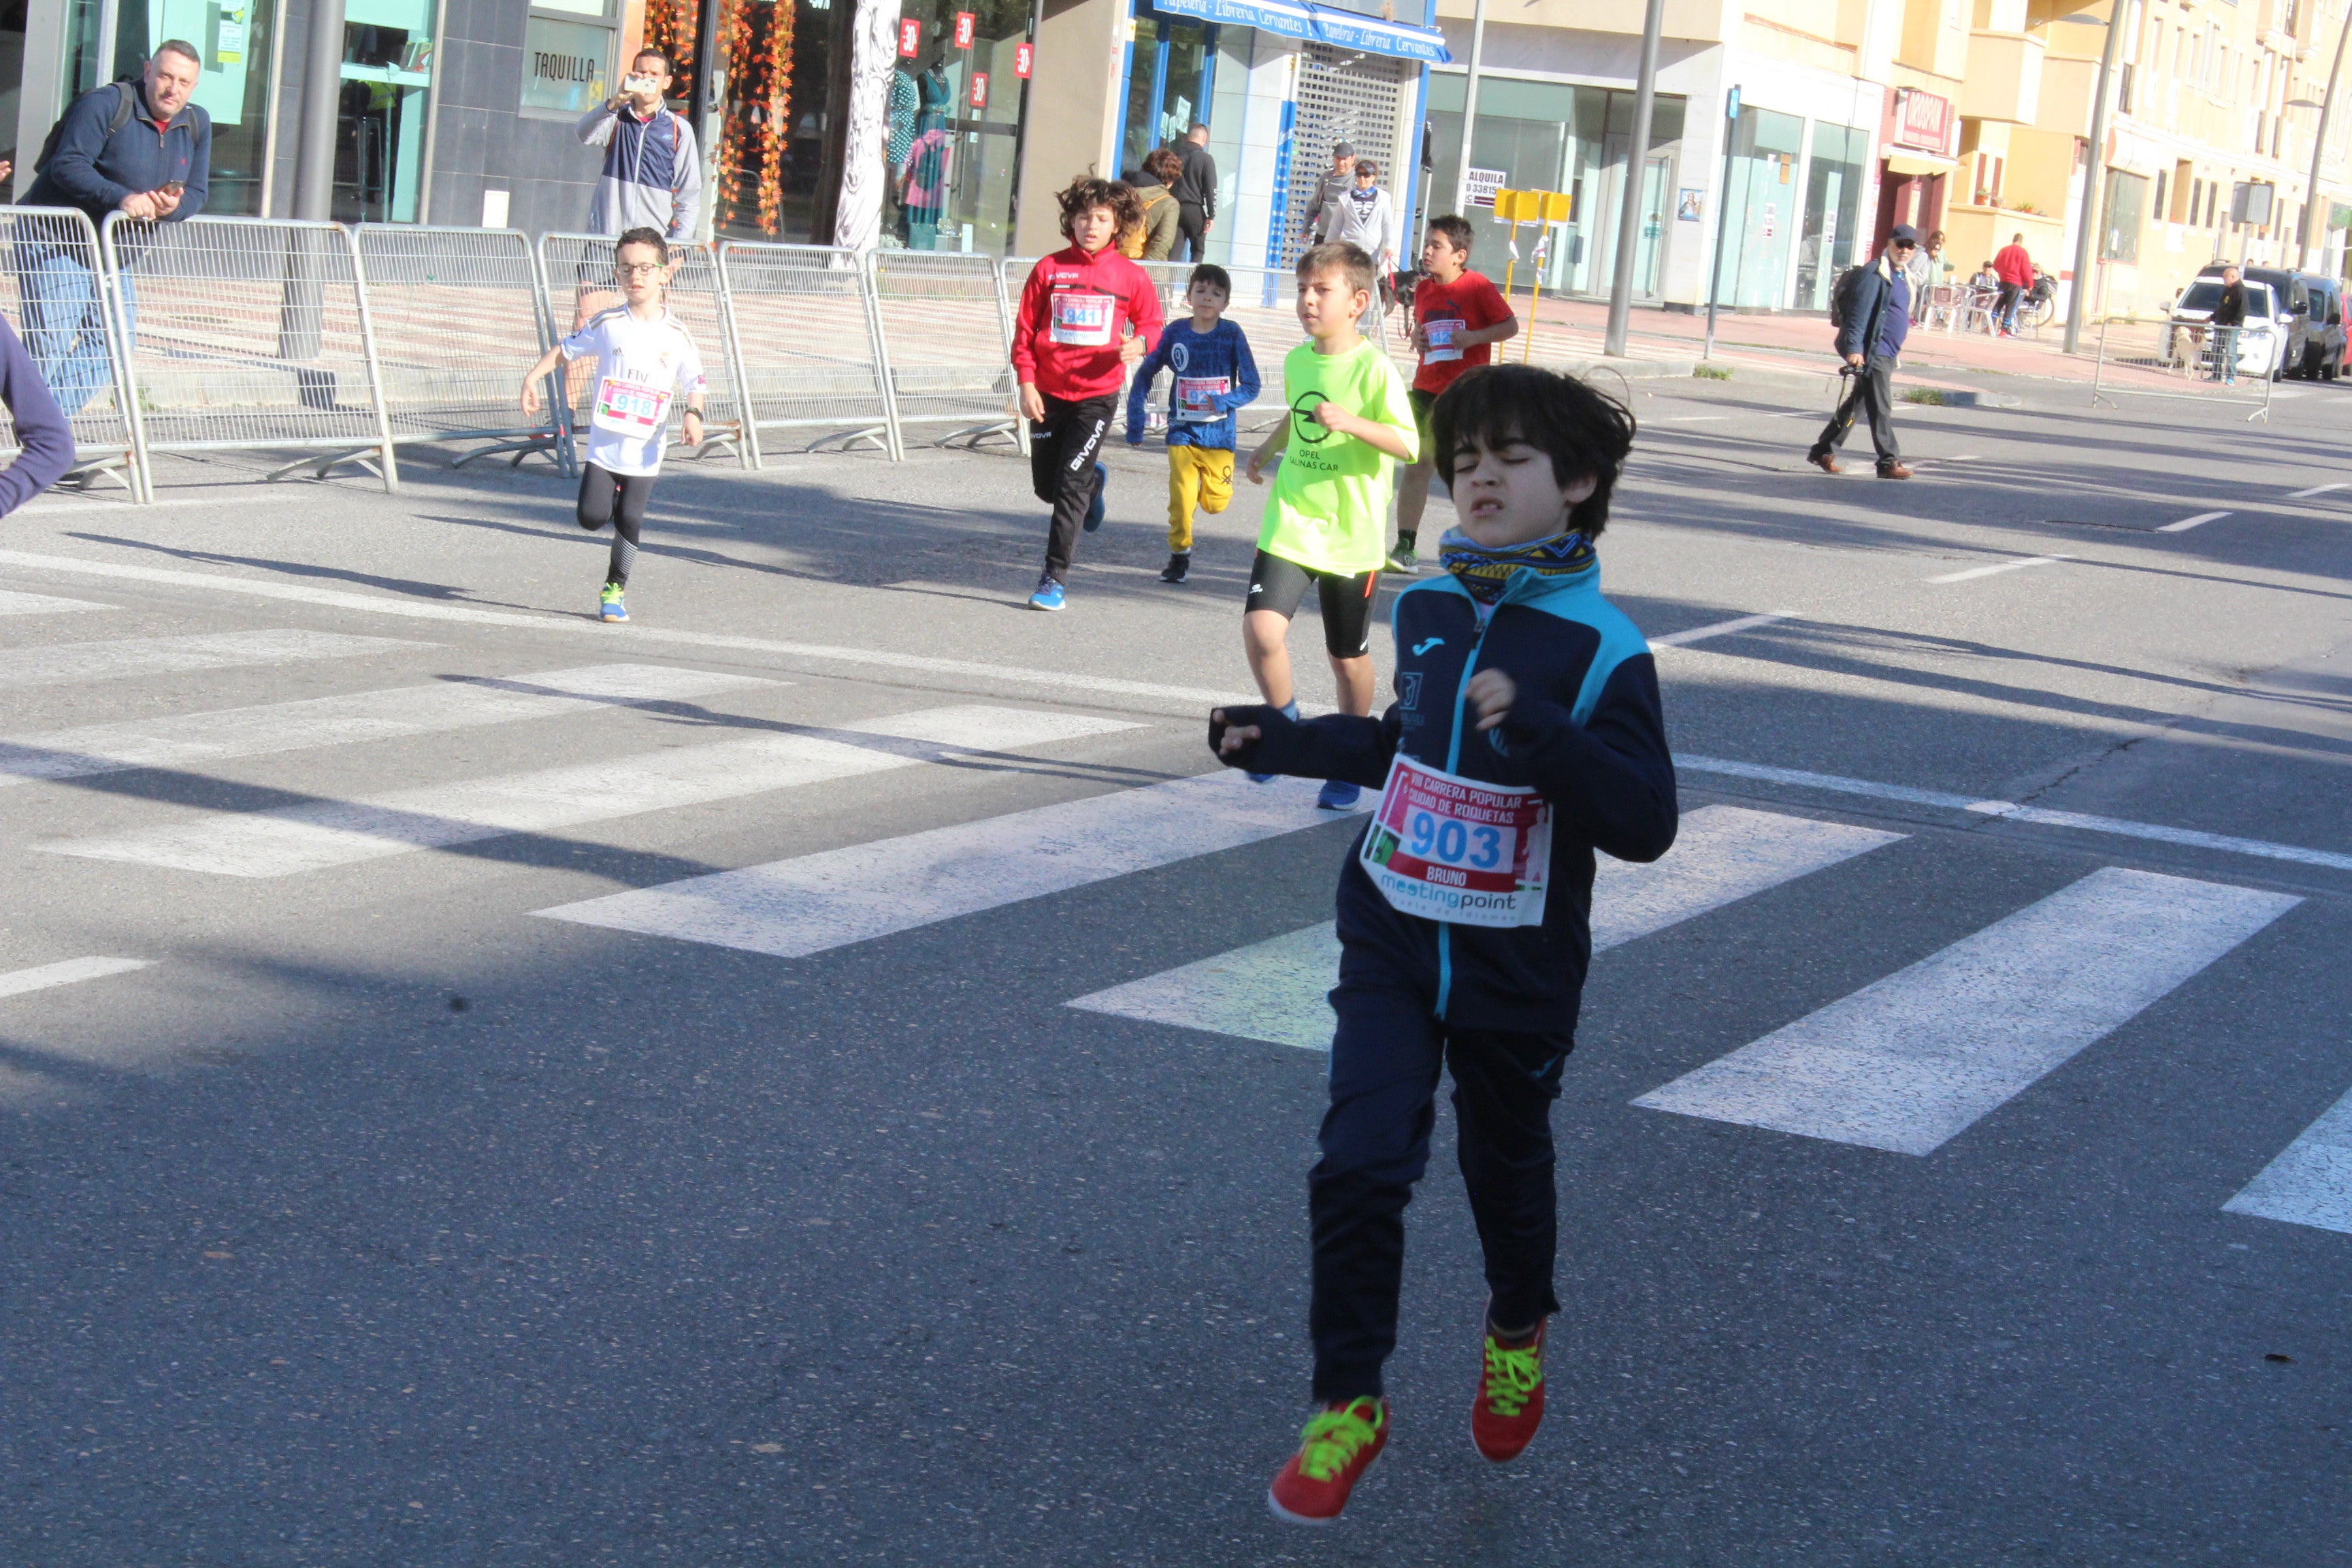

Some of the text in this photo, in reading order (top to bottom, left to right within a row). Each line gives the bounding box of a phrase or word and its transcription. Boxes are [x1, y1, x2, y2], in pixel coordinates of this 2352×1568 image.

[1259, 9, 1303, 33] Cervantes
[1396, 36, 1435, 56] Cervantes
[534, 52, 595, 83] TAQUILLA
[1469, 171, 1503, 184] ALQUILA
[1472, 184, 1501, 195] 33815
[1066, 309, 1095, 325] 941
[1430, 331, 1451, 344] 42
[617, 395, 651, 416] 918
[1070, 419, 1105, 471] GIVOVA
[1299, 449, 1320, 459] OPEL
[1320, 463, 1339, 472] CAR
[1424, 778, 1467, 801] CARRERA
[1469, 790, 1522, 808] POPULAR
[1408, 787, 1514, 823] CIUDAD DE ROQUETAS
[1411, 811, 1501, 869] 903
[1426, 866, 1467, 887] BRUNO
[1382, 874, 1516, 909] meetingpoint
